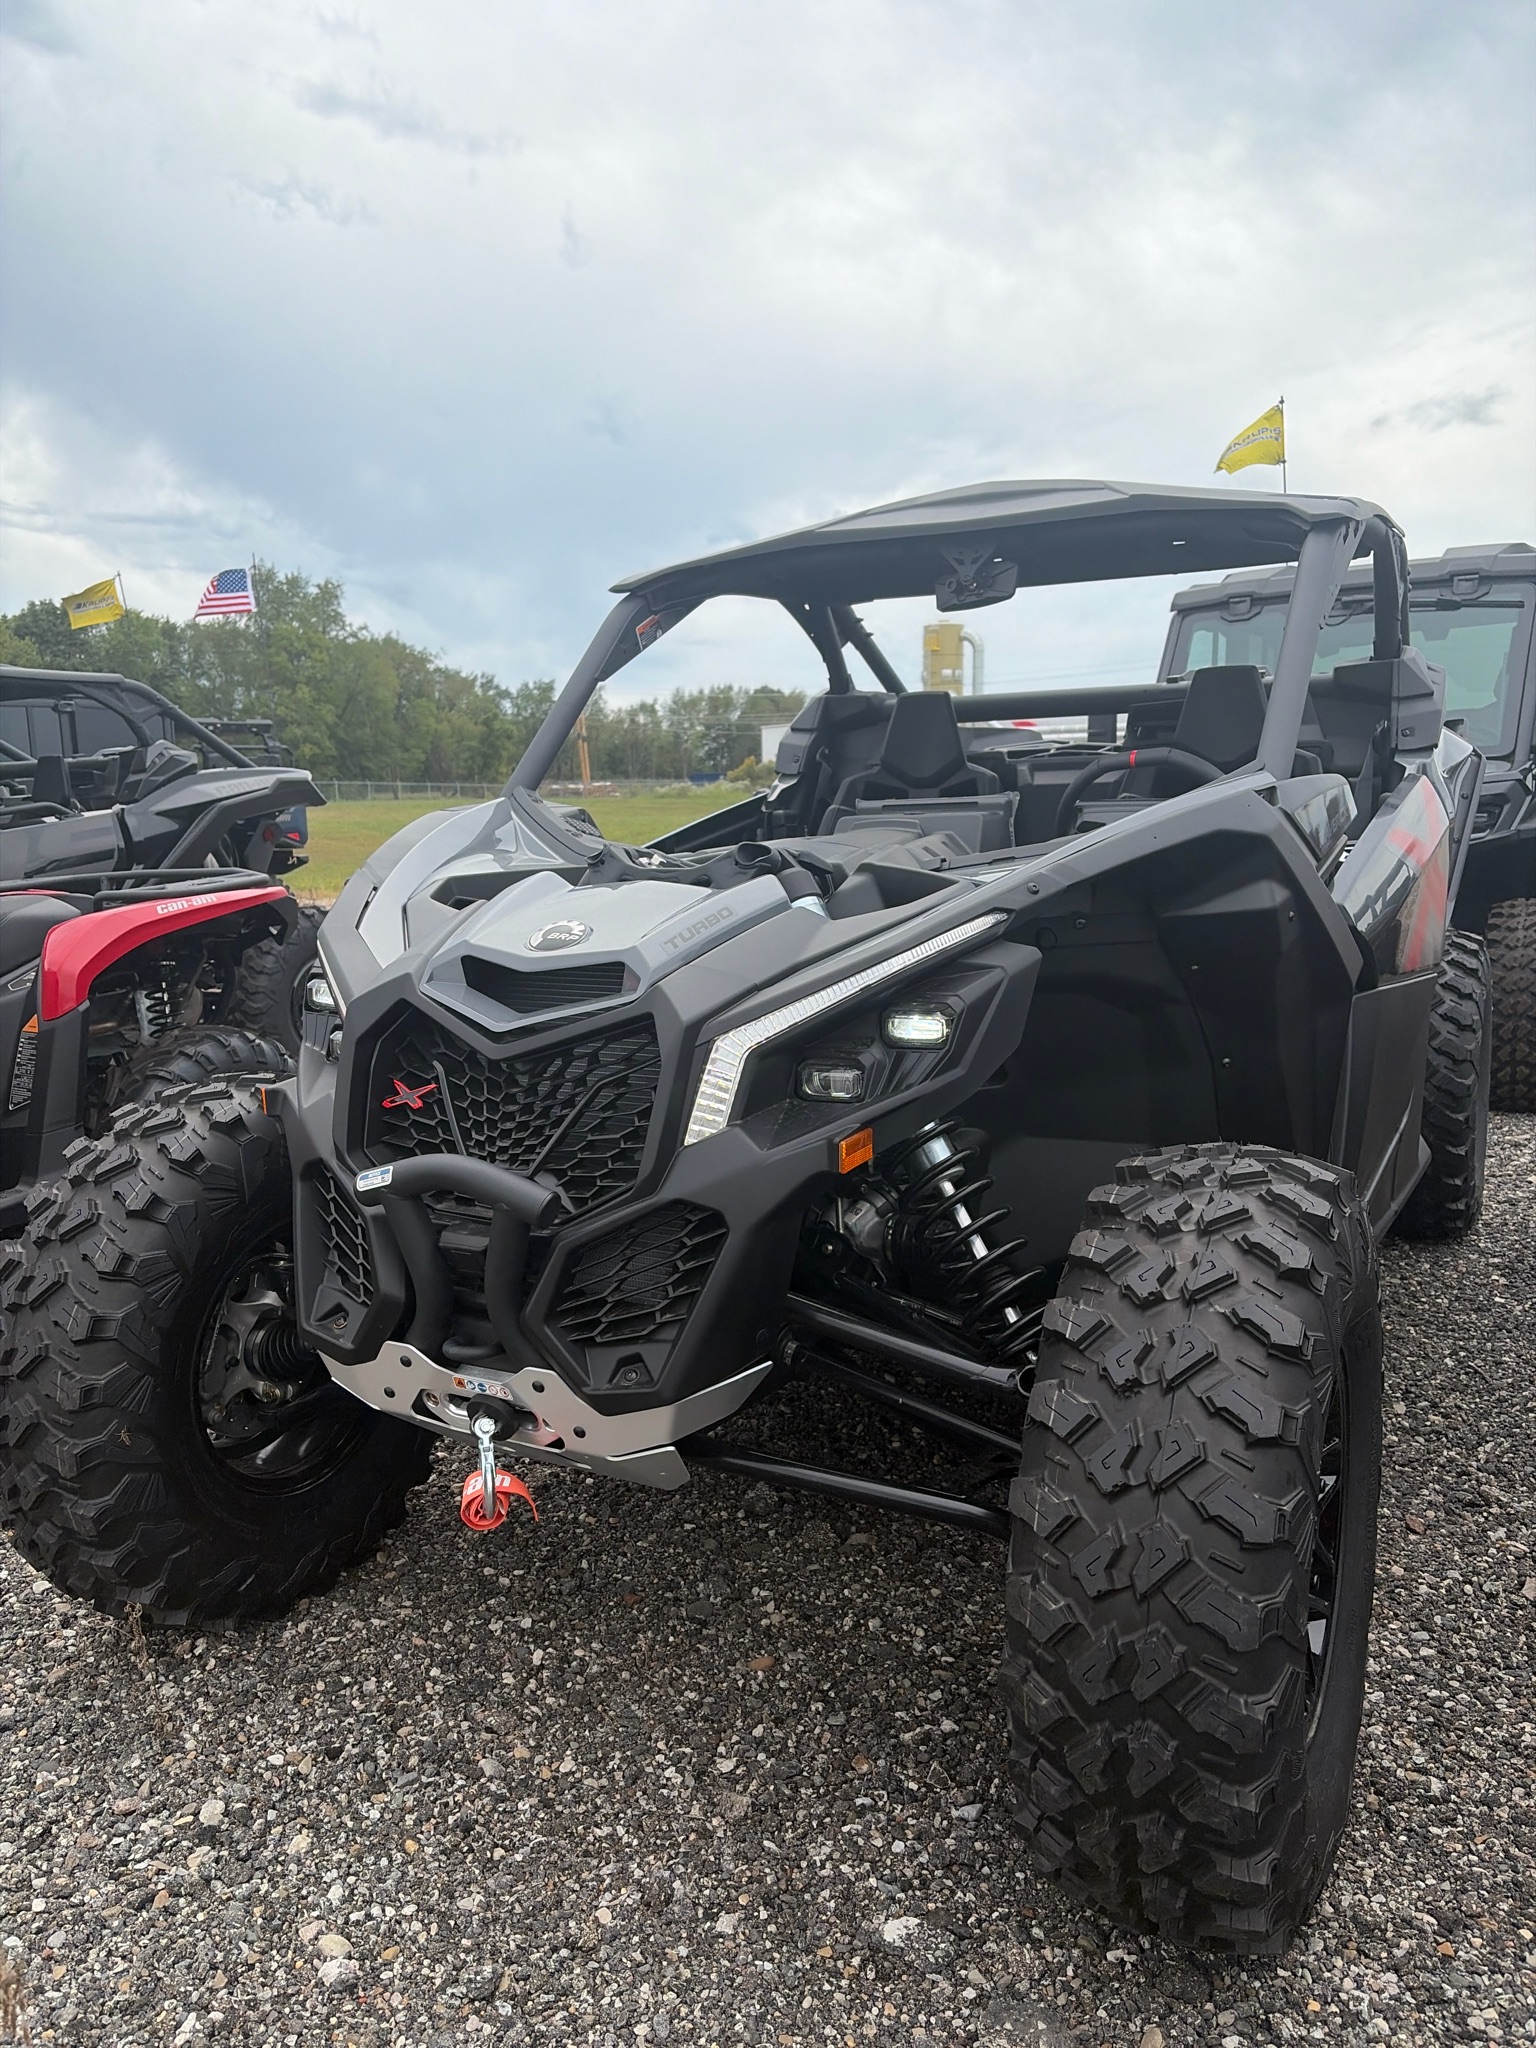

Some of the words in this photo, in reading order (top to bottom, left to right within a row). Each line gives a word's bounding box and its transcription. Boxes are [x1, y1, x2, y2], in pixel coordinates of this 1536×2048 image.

[156, 895, 218, 915] can-am
[546, 932, 580, 941] BRP
[663, 906, 734, 950] TURBO
